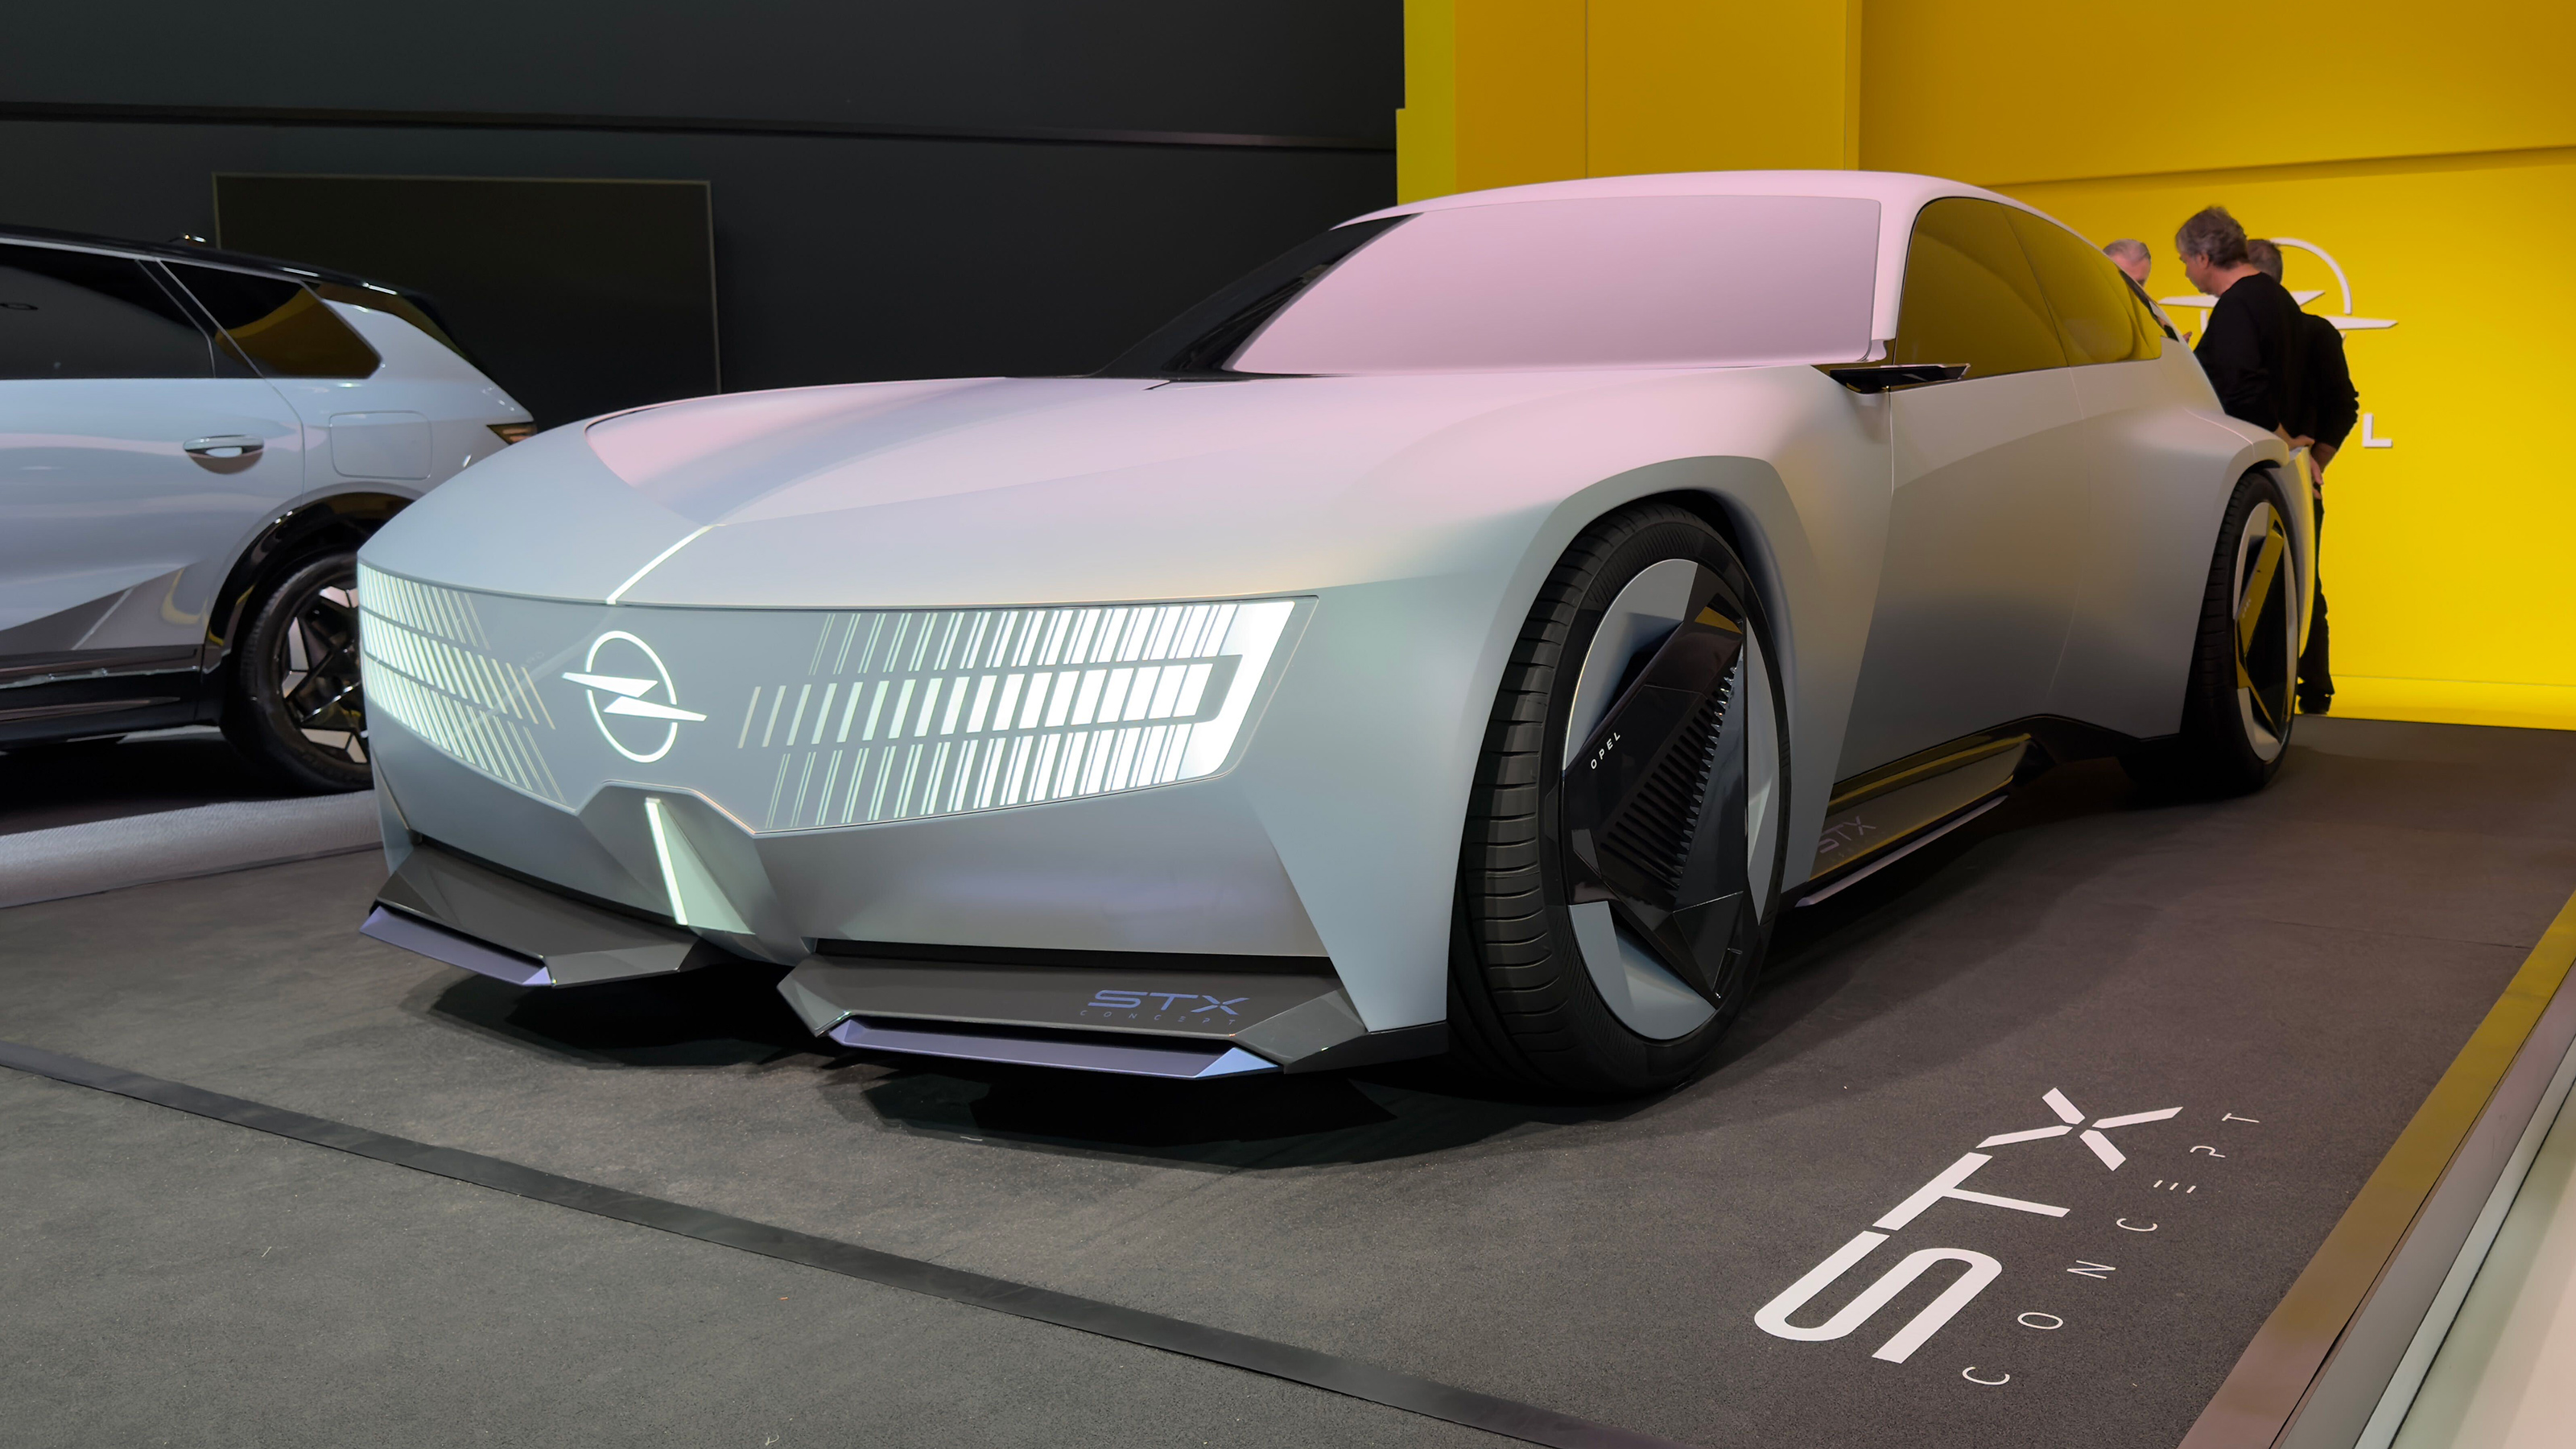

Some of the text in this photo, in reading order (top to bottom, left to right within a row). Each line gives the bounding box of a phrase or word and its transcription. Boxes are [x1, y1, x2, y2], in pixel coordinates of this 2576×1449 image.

[1591, 732, 1620, 770] OPEL
[1080, 1009, 1236, 1026] CONCEPT
[1088, 989, 1250, 1016] STX
[1754, 1088, 2183, 1364] STX
[1962, 1113, 2260, 1385] CONCEPT
